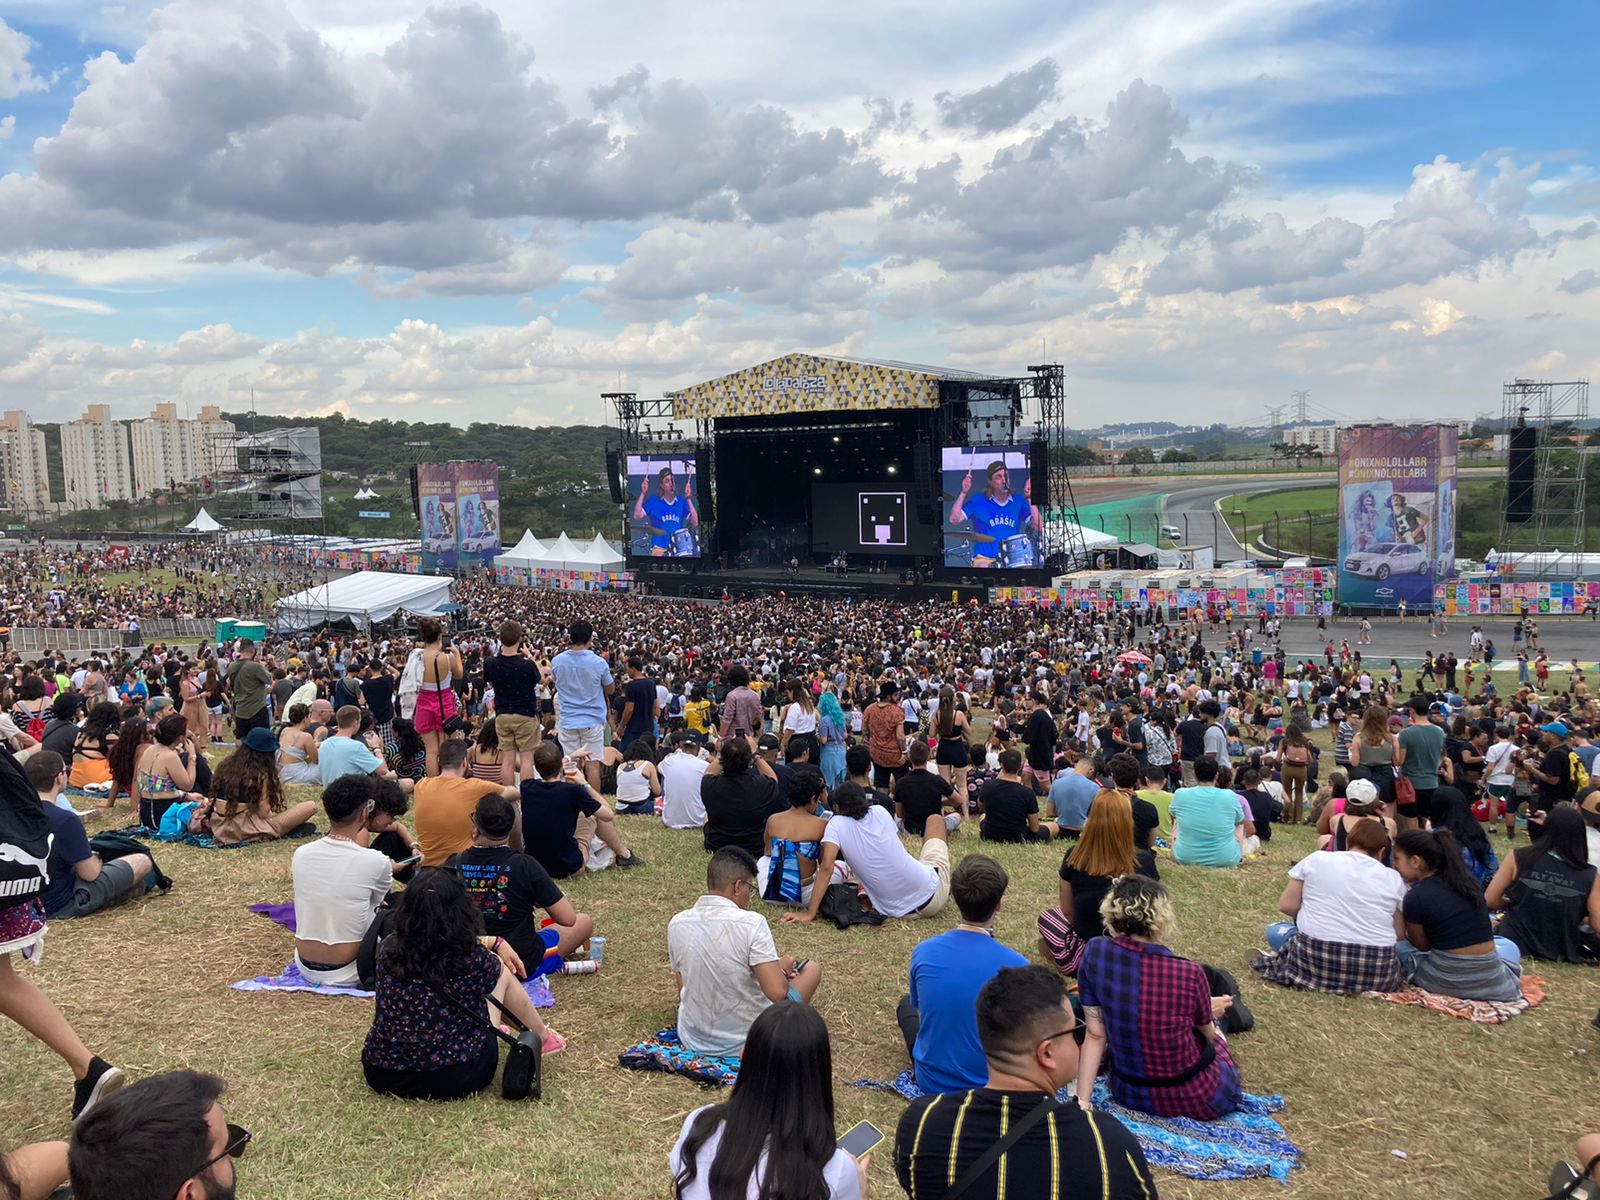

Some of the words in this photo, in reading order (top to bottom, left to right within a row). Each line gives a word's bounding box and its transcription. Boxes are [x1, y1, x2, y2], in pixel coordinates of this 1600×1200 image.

[1349, 457, 1427, 468] #ONIXNOLOLLABR
[1349, 468, 1427, 478] #ONIXNOLOLLABR
[989, 516, 1015, 528] BRASIL
[0, 876, 41, 896] UMA
